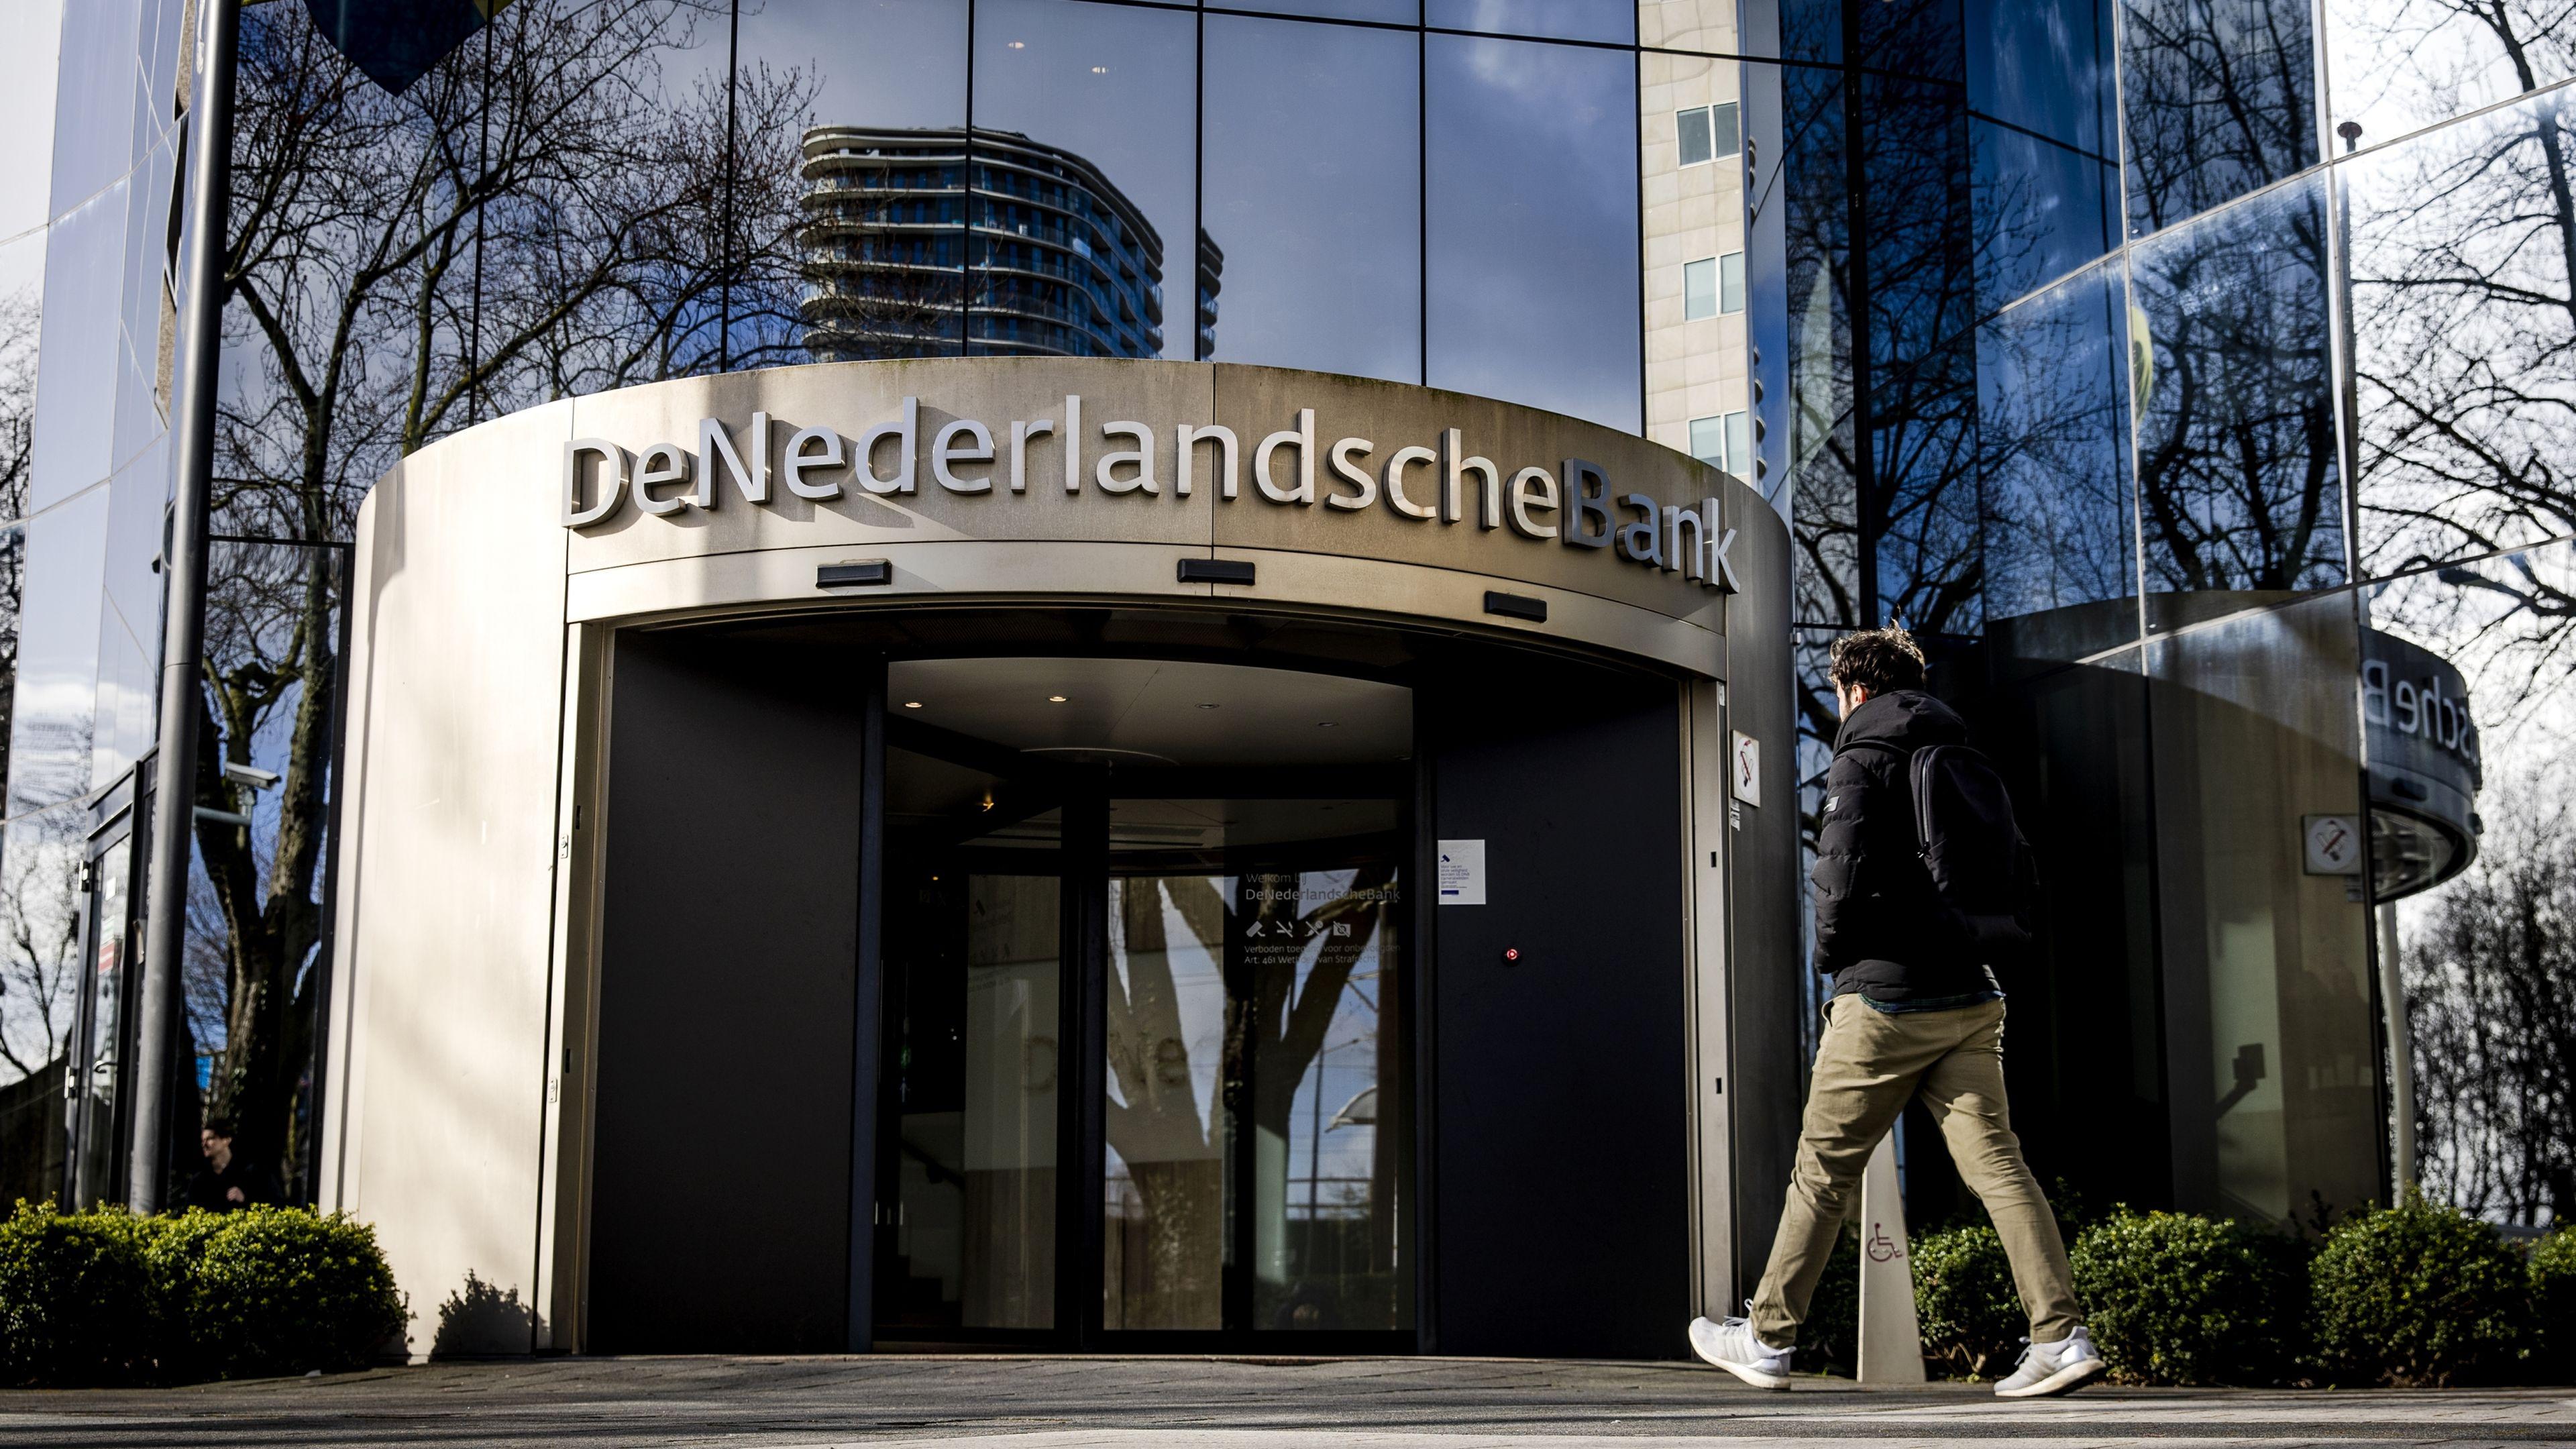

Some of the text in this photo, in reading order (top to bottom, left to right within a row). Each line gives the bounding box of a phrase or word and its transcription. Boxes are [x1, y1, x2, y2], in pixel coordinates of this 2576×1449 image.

[561, 394, 1740, 595] DeNederlandscheBank
[1246, 873, 1291, 883] Welkom
[1246, 888, 1401, 900] DeNederlandscheBank
[1244, 945, 1285, 953] Verboden
[1344, 944, 1401, 954] onbeoegden
